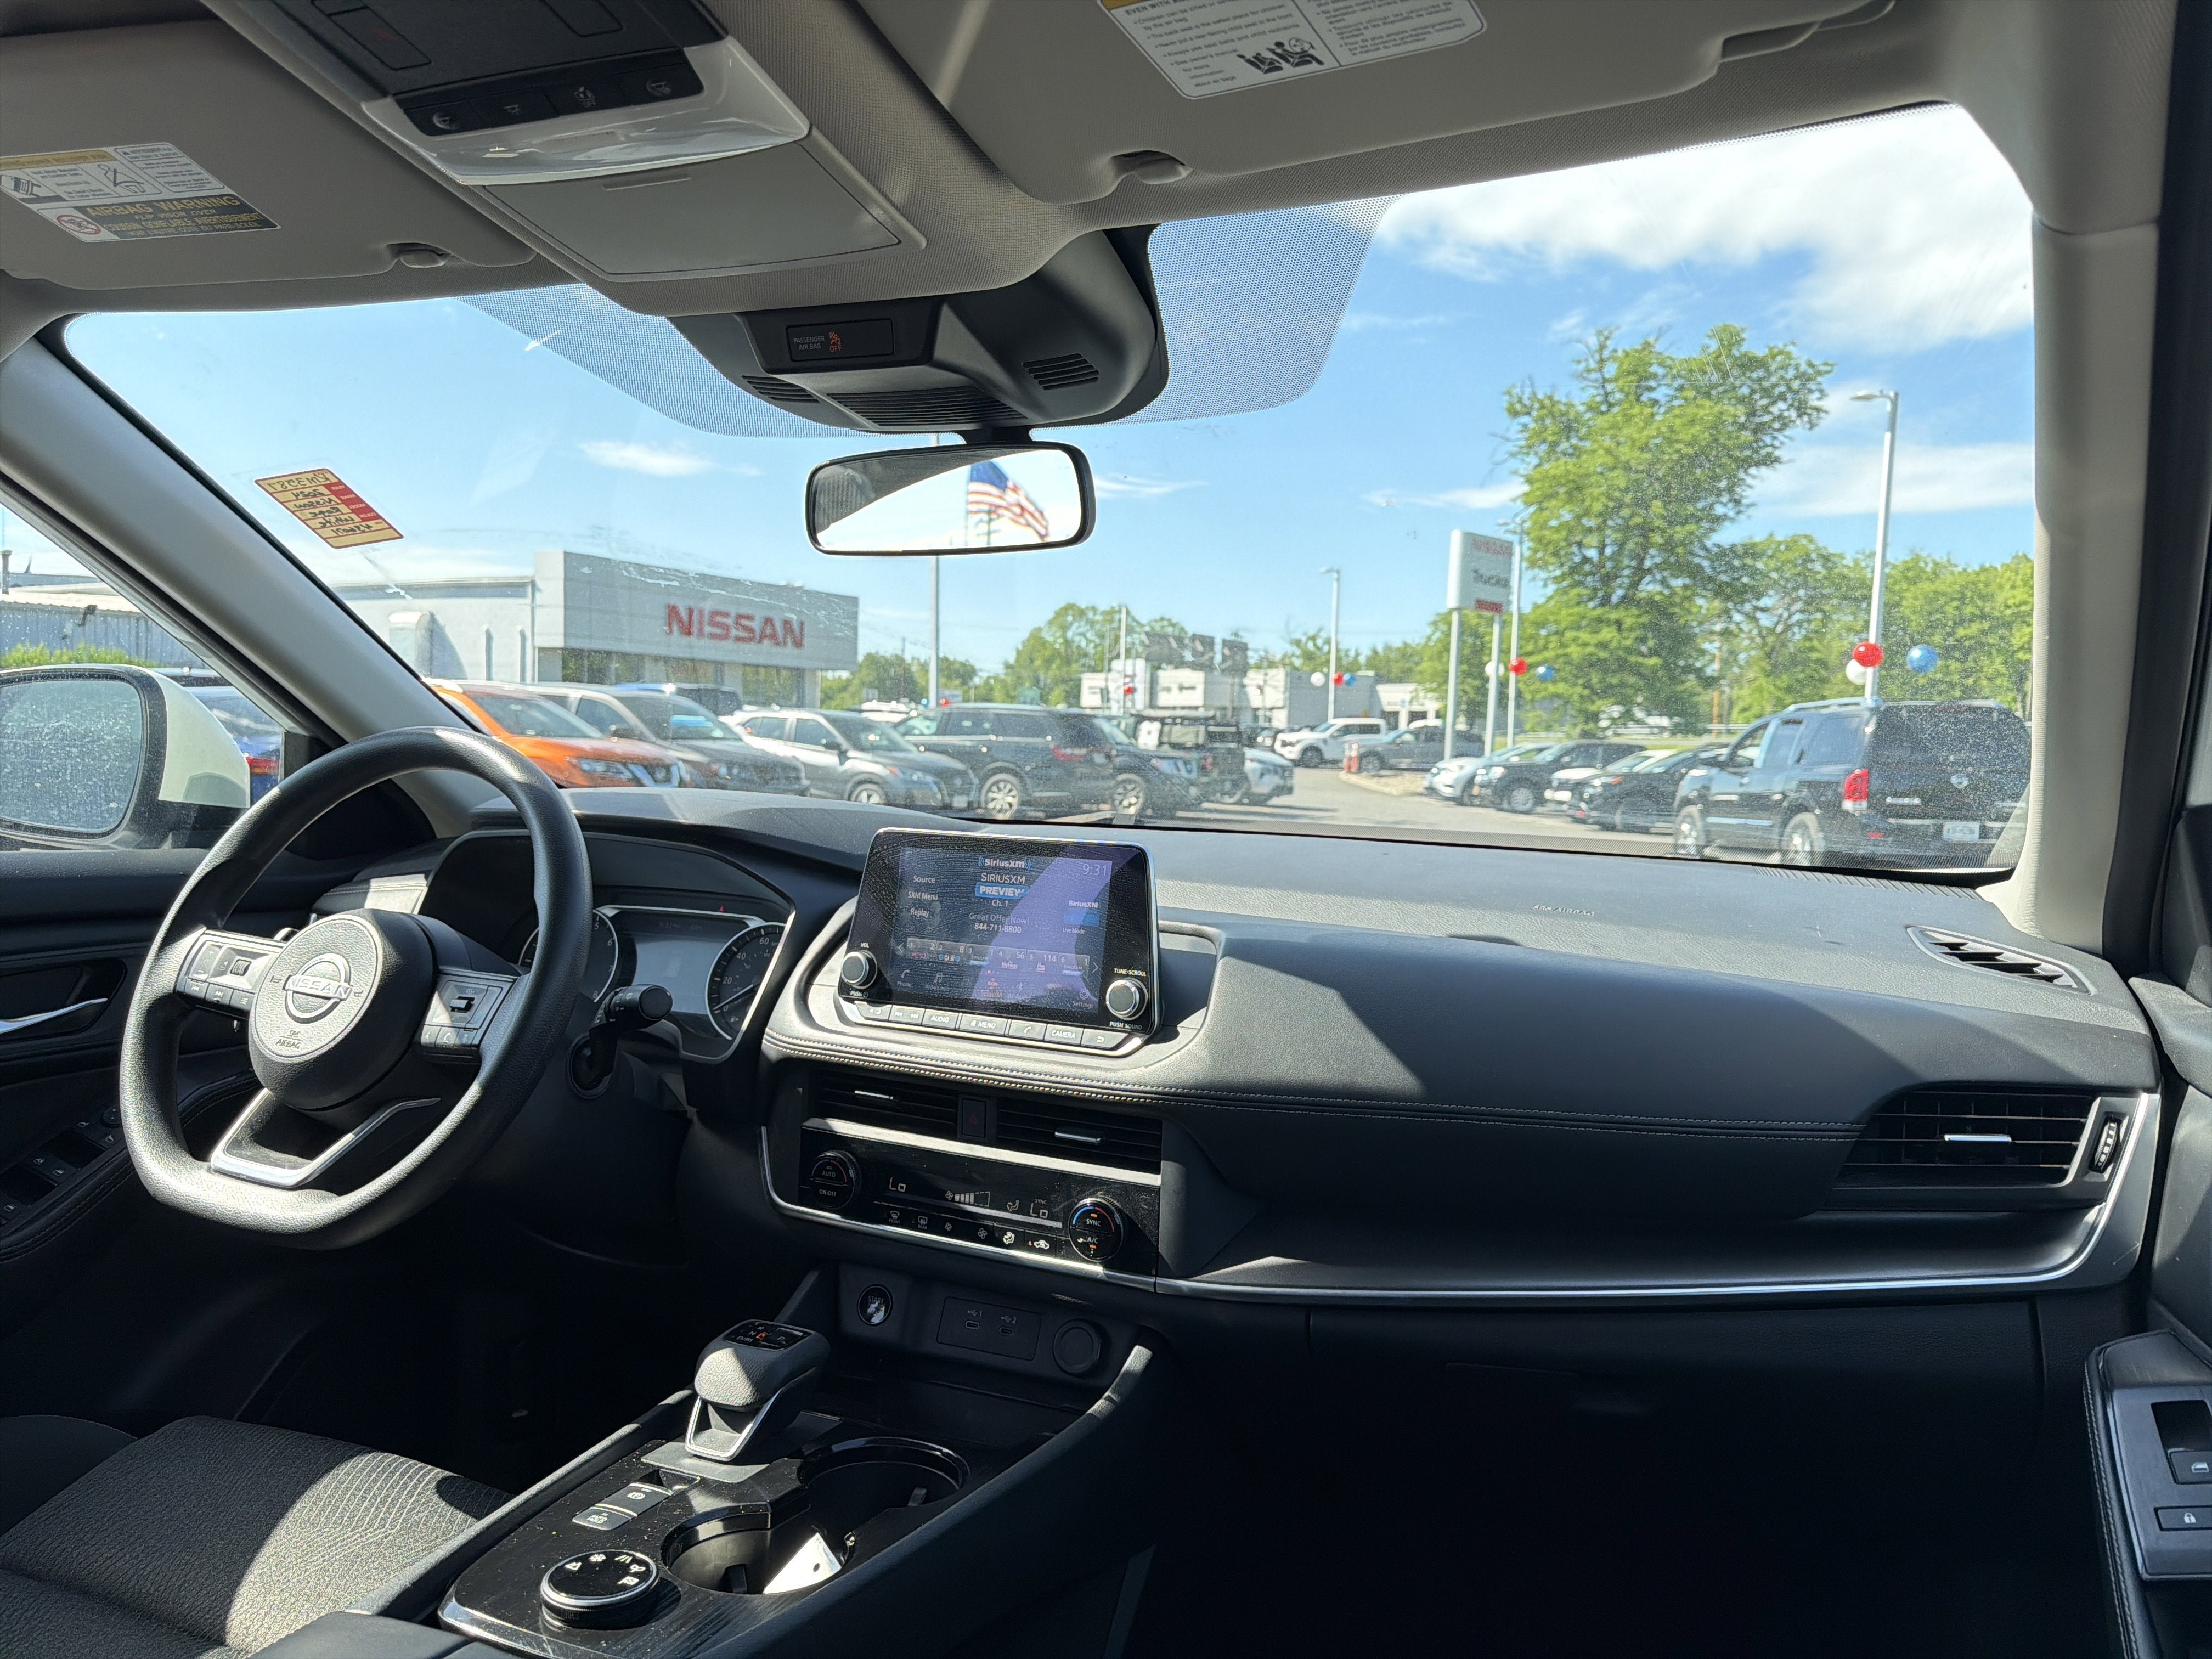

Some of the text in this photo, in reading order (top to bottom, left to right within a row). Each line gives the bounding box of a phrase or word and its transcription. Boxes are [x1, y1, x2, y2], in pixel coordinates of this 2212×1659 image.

[87, 196, 242, 217] AIRBAG WARNING
[793, 336, 825, 344] PASSENGER
[666, 604, 806, 649] NISSAN
[1082, 864, 1107, 876] 9:31
[913, 875, 936, 884] Source
[980, 872, 1025, 884] SIRIUSXM
[979, 885, 1025, 897] PREVIEW
[907, 891, 939, 901] SXM Menu
[1068, 900, 1098, 909] SiriusXM
[909, 908, 930, 918] Replay
[969, 912, 989, 921] Great
[990, 914, 1009, 922] Offer
[974, 922, 1022, 934] 844-711-8800
[759, 937, 769, 945] 60
[1015, 951, 1025, 960] 56
[1043, 954, 1057, 962] 114
[723, 977, 732, 985] 20
[286, 975, 352, 999] NISSAN
[1072, 1000, 1094, 1009] Settings
[930, 1015, 950, 1023] AUDIO
[977, 1020, 996, 1029] MENU
[1051, 1030, 1076, 1039] CAMERA
[1086, 1218, 1101, 1227] SYNC
[1087, 1236, 1098, 1244] A/C
